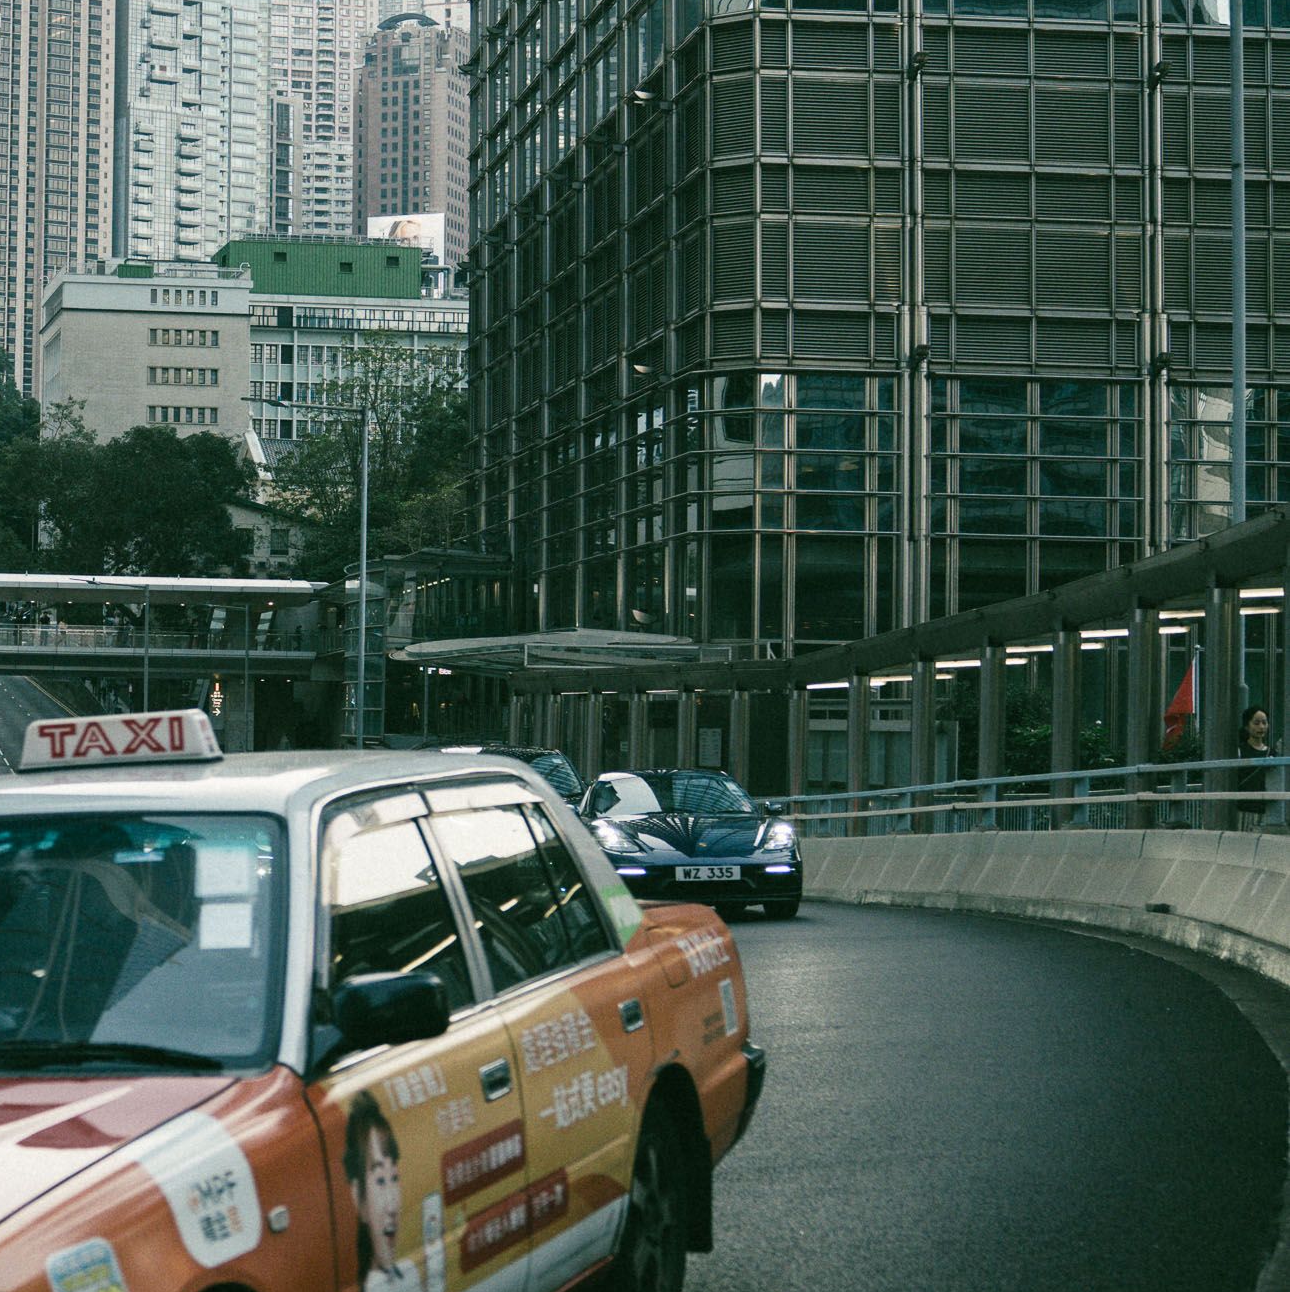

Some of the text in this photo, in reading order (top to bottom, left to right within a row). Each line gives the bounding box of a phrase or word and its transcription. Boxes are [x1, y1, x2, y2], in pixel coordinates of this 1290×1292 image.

[38, 716, 185, 758] TAXI
[683, 867, 734, 879] WZ 335
